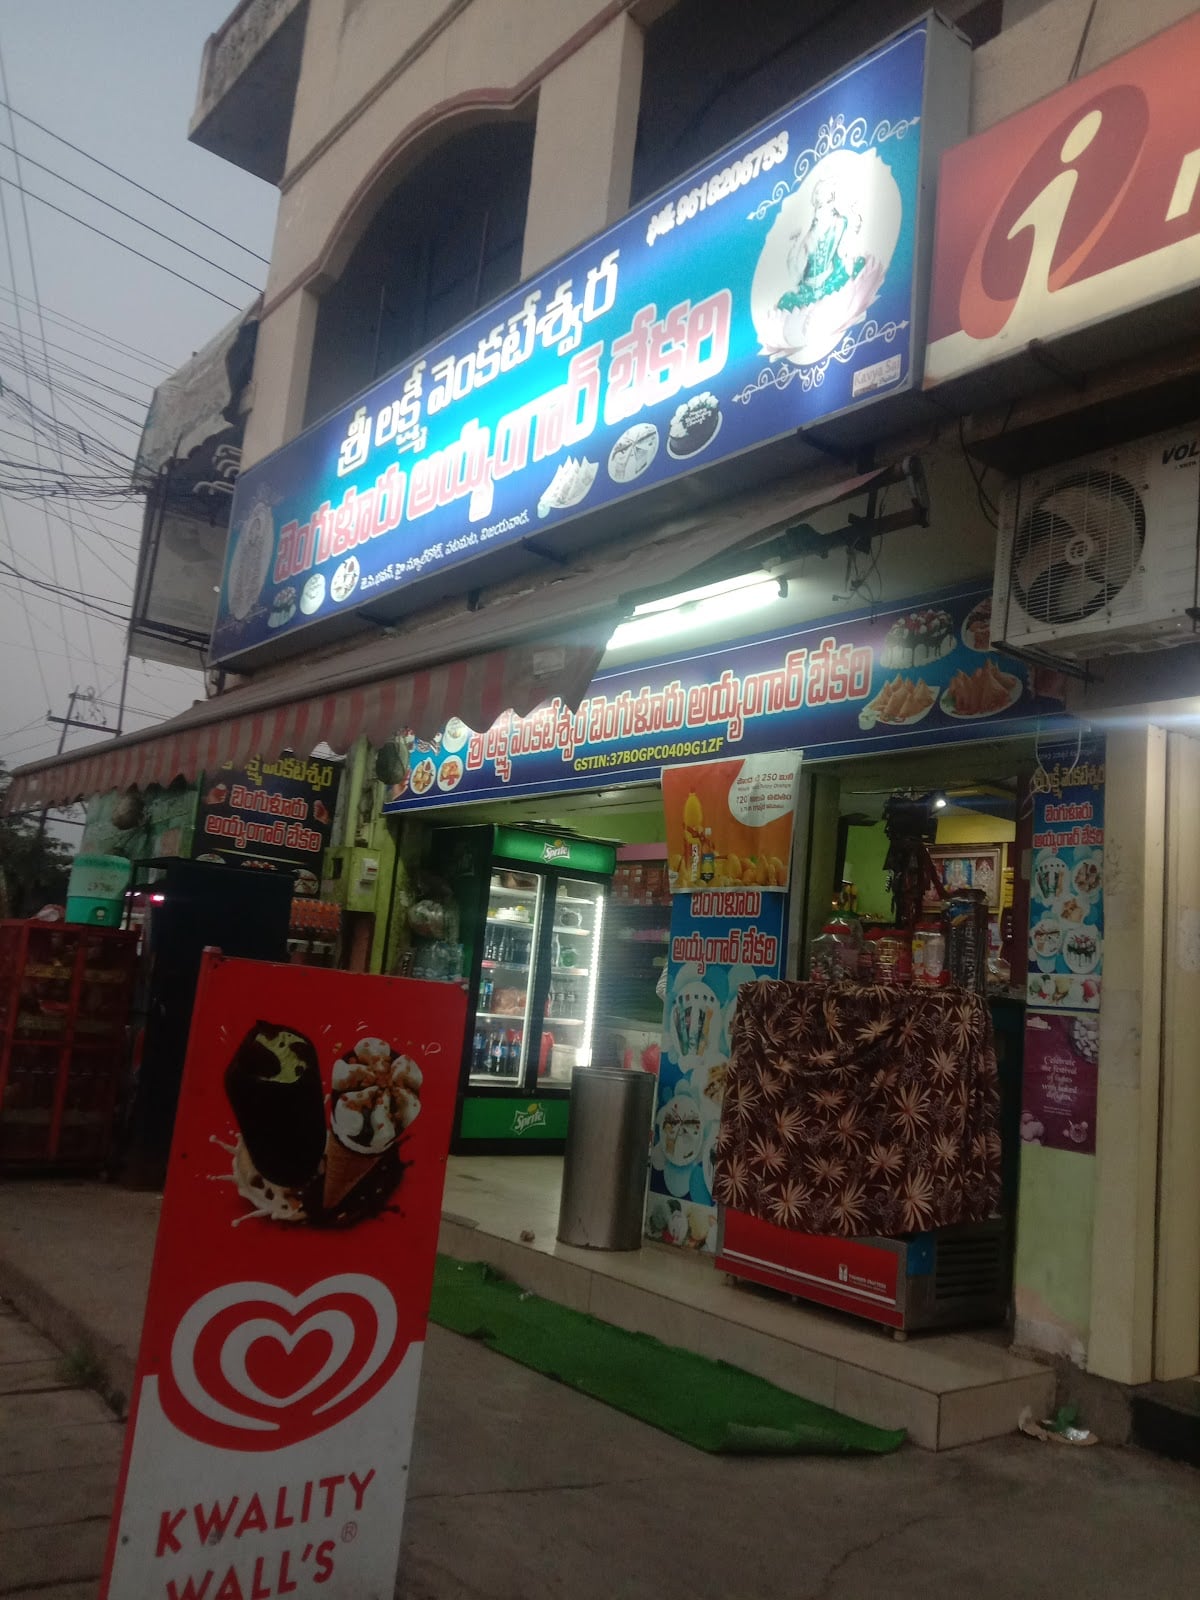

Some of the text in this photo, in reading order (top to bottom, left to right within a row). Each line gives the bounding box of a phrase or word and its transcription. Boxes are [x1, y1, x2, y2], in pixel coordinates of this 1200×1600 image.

[337, 248, 621, 478] శ్రీ లక్ష్మీ వెంకటేశ్వర
[273, 463, 407, 584] బెంగుళూరు
[405, 341, 604, 523] అయ్యంగార్
[588, 679, 686, 743] బెంగుళూరు
[686, 648, 808, 743] అయ్యంగార్
[544, 846, 568, 860] Sprite
[514, 1111, 544, 1131] Sprite
[155, 1468, 376, 1558] KWALITY
